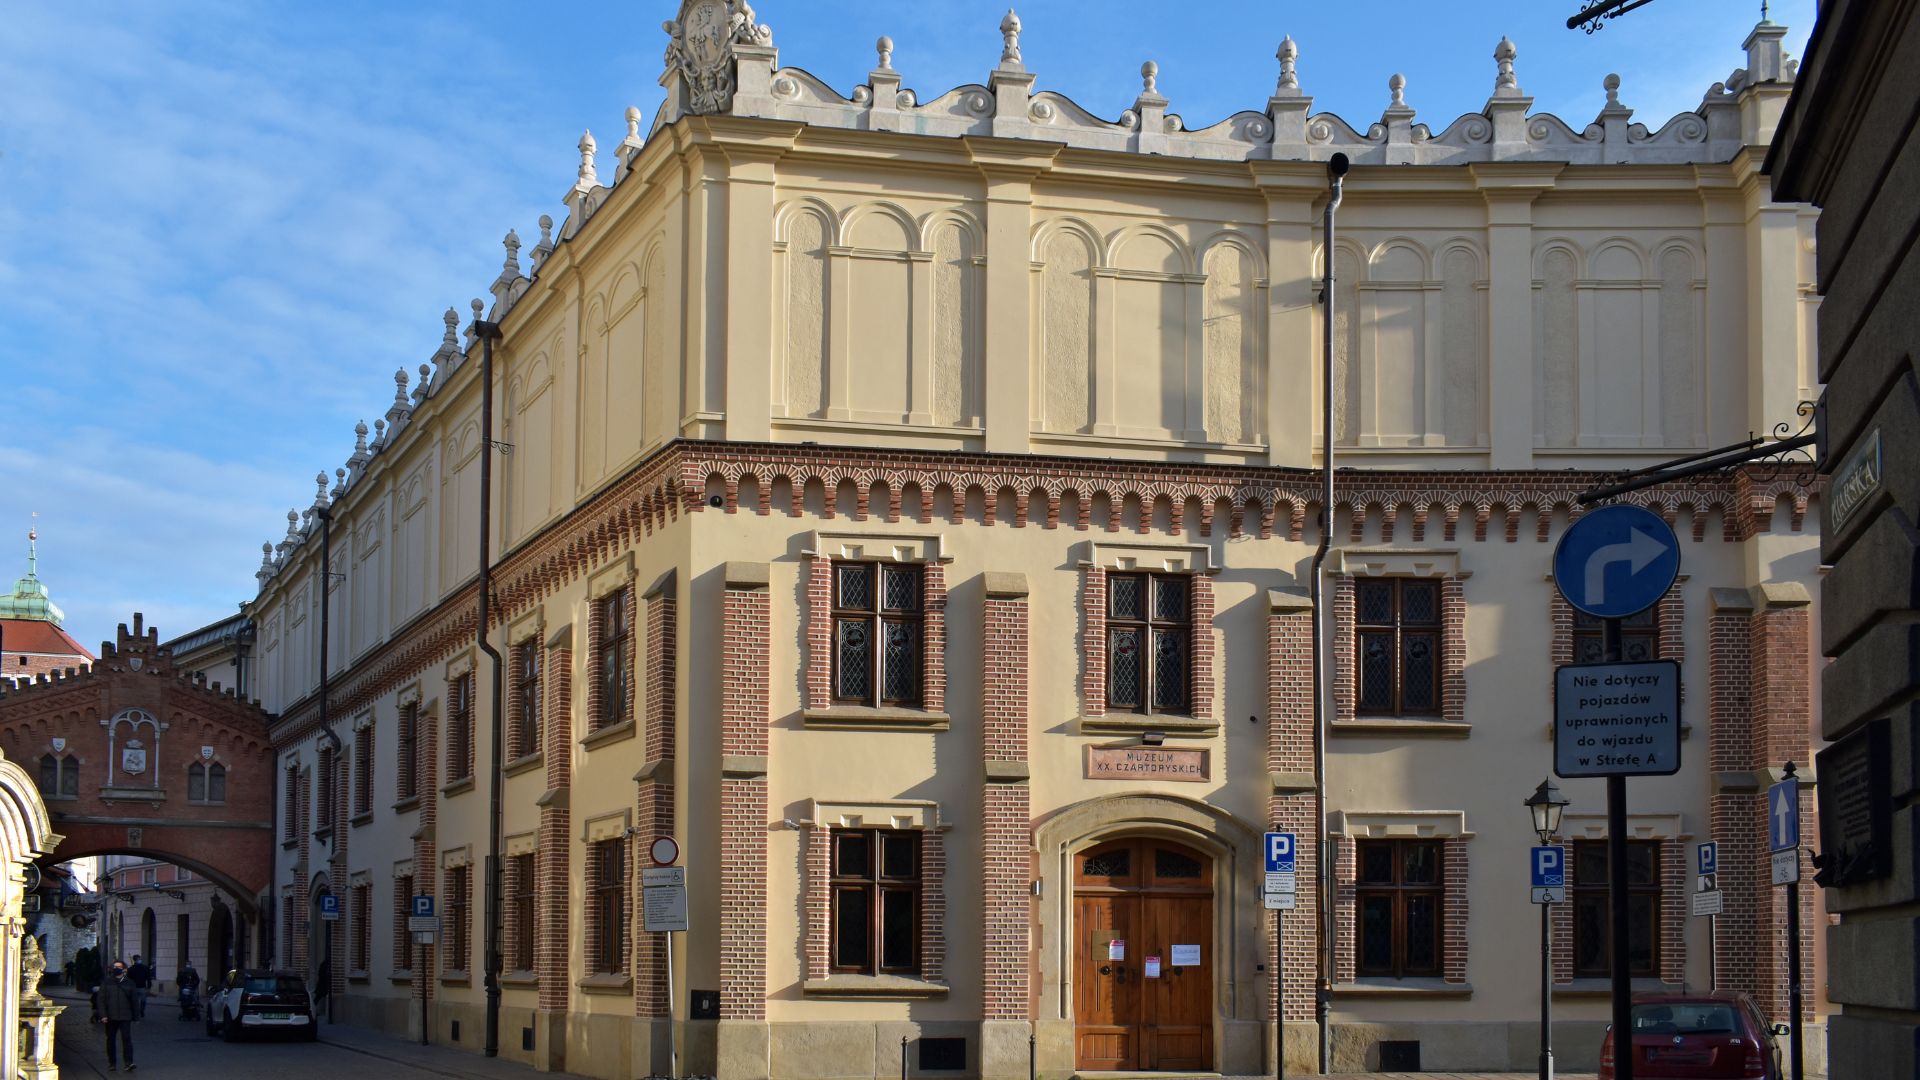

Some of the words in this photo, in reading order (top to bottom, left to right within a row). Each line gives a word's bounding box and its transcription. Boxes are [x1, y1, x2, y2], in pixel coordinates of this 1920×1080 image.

[1573, 676, 1598, 687] Nie
[1604, 674, 1660, 688] dotyczy
[1579, 693, 1651, 709] pojazdów
[1566, 713, 1668, 729] uprawnionych
[1577, 736, 1596, 746] do
[1602, 734, 1653, 748] wjazdu
[1127, 752, 1174, 763] MUZEUM
[1579, 757, 1590, 766] w
[1596, 753, 1641, 767] Strefę
[1647, 753, 1657, 764] A
[1097, 762, 1112, 770] XX.
[1116, 762, 1202, 773] CZARTORYSKICH
[1271, 836, 1290, 861] P
[1538, 850, 1558, 875] P
[1701, 845, 1712, 870] P
[325, 898, 335, 910] P
[417, 898, 429, 914] P
